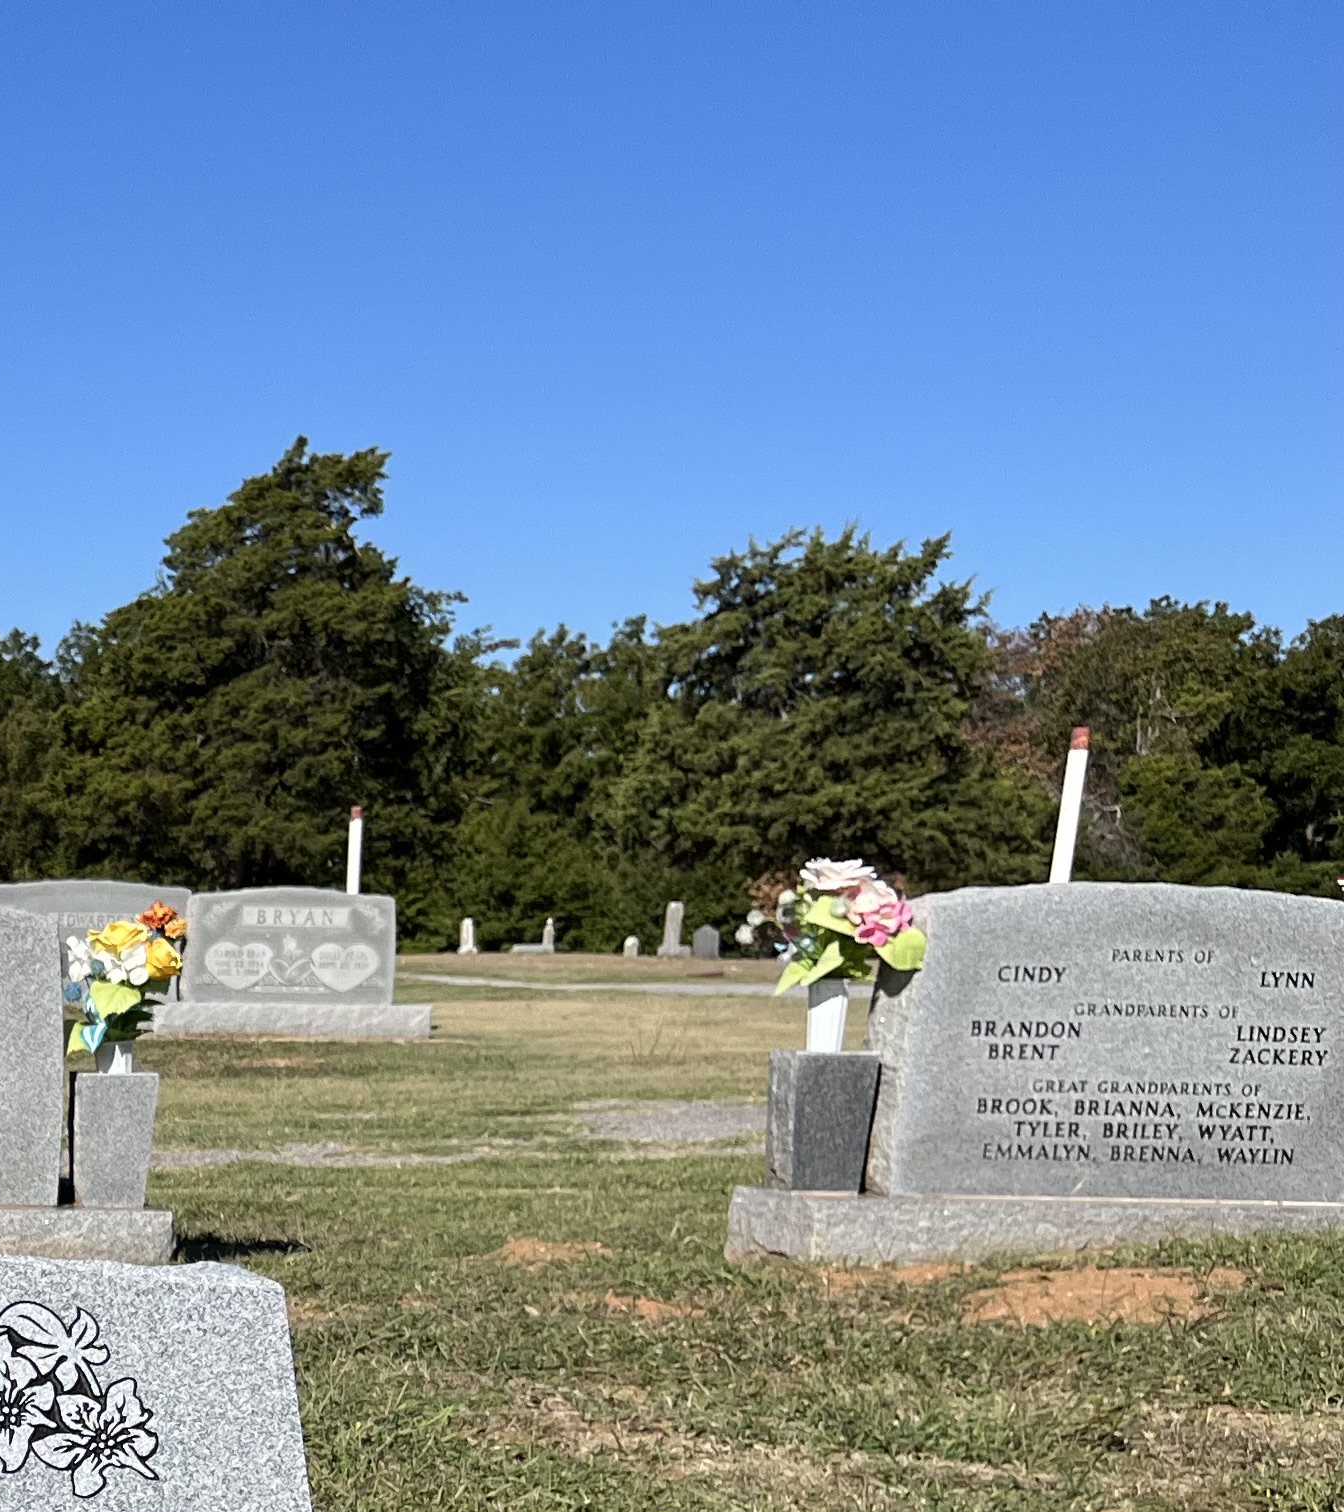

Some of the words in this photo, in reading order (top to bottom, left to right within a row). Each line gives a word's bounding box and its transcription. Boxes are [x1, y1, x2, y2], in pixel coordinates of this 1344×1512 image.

[256, 909, 334, 925] BRYAN
[1111, 948, 1185, 964] PARENTS
[1194, 949, 1214, 964] OF
[997, 965, 1068, 984] CINDY
[1260, 971, 1316, 989] LYNN
[1074, 1002, 1209, 1019] GRANDPARENTS
[1218, 1005, 1240, 1020] OF
[970, 1020, 1083, 1039] BRANDON
[1236, 1025, 1328, 1044] LINDSEY
[988, 1043, 1061, 1061] BRENT
[1228, 1048, 1330, 1067] ZACKERY
[1032, 1078, 1088, 1094] GREAT
[1097, 1080, 1232, 1096] GRANDPARENTS
[1241, 1083, 1263, 1098] OF
[976, 1097, 1059, 1118] BROOK,
[1073, 1098, 1182, 1119] BRIANNA,
[1013, 1120, 1087, 1141] TYLER,
[1102, 1122, 1183, 1143] BRILEY,
[1198, 1124, 1275, 1144] WYATT,
[1110, 1145, 1202, 1165] BRENNA,
[1217, 1147, 1295, 1166] WAYLIN
